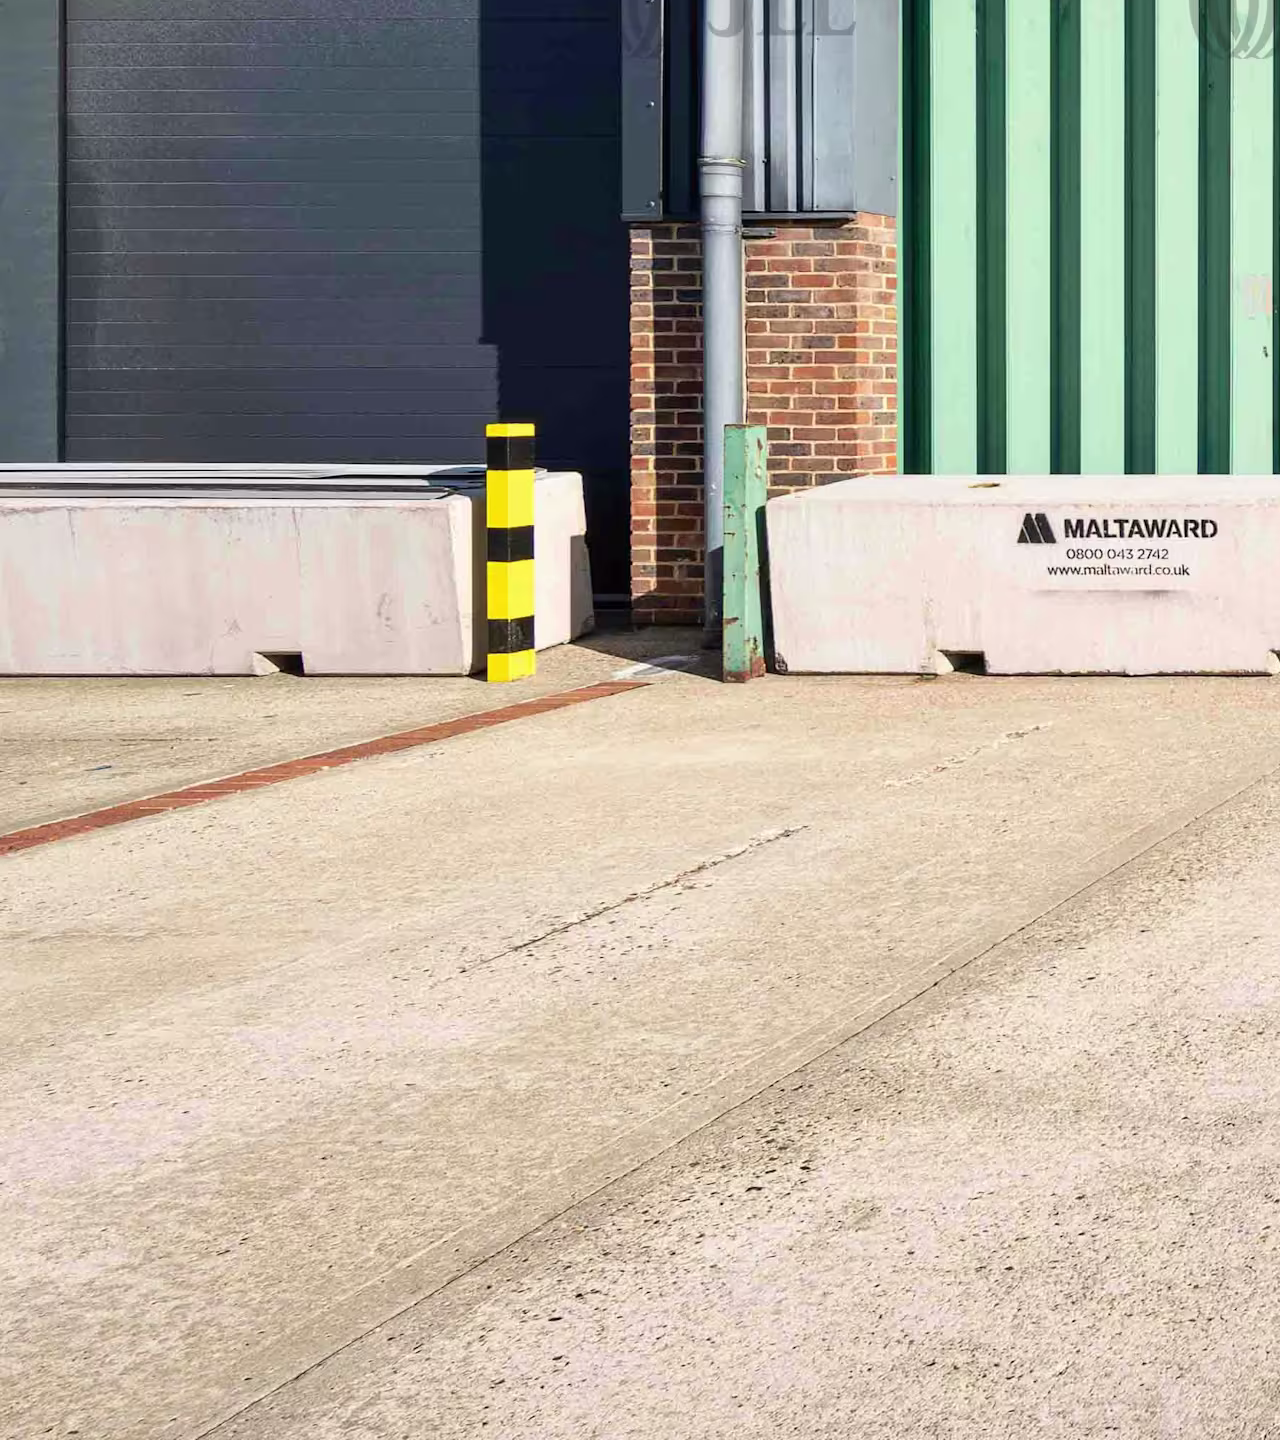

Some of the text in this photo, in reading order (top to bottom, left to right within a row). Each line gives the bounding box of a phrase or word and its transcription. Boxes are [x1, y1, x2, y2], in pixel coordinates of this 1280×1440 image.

[1063, 518, 1218, 538] MALTAWARD
[1066, 548, 1169, 560] 0800 043 2742
[1047, 563, 1191, 576] www.maltaward.co.uk
